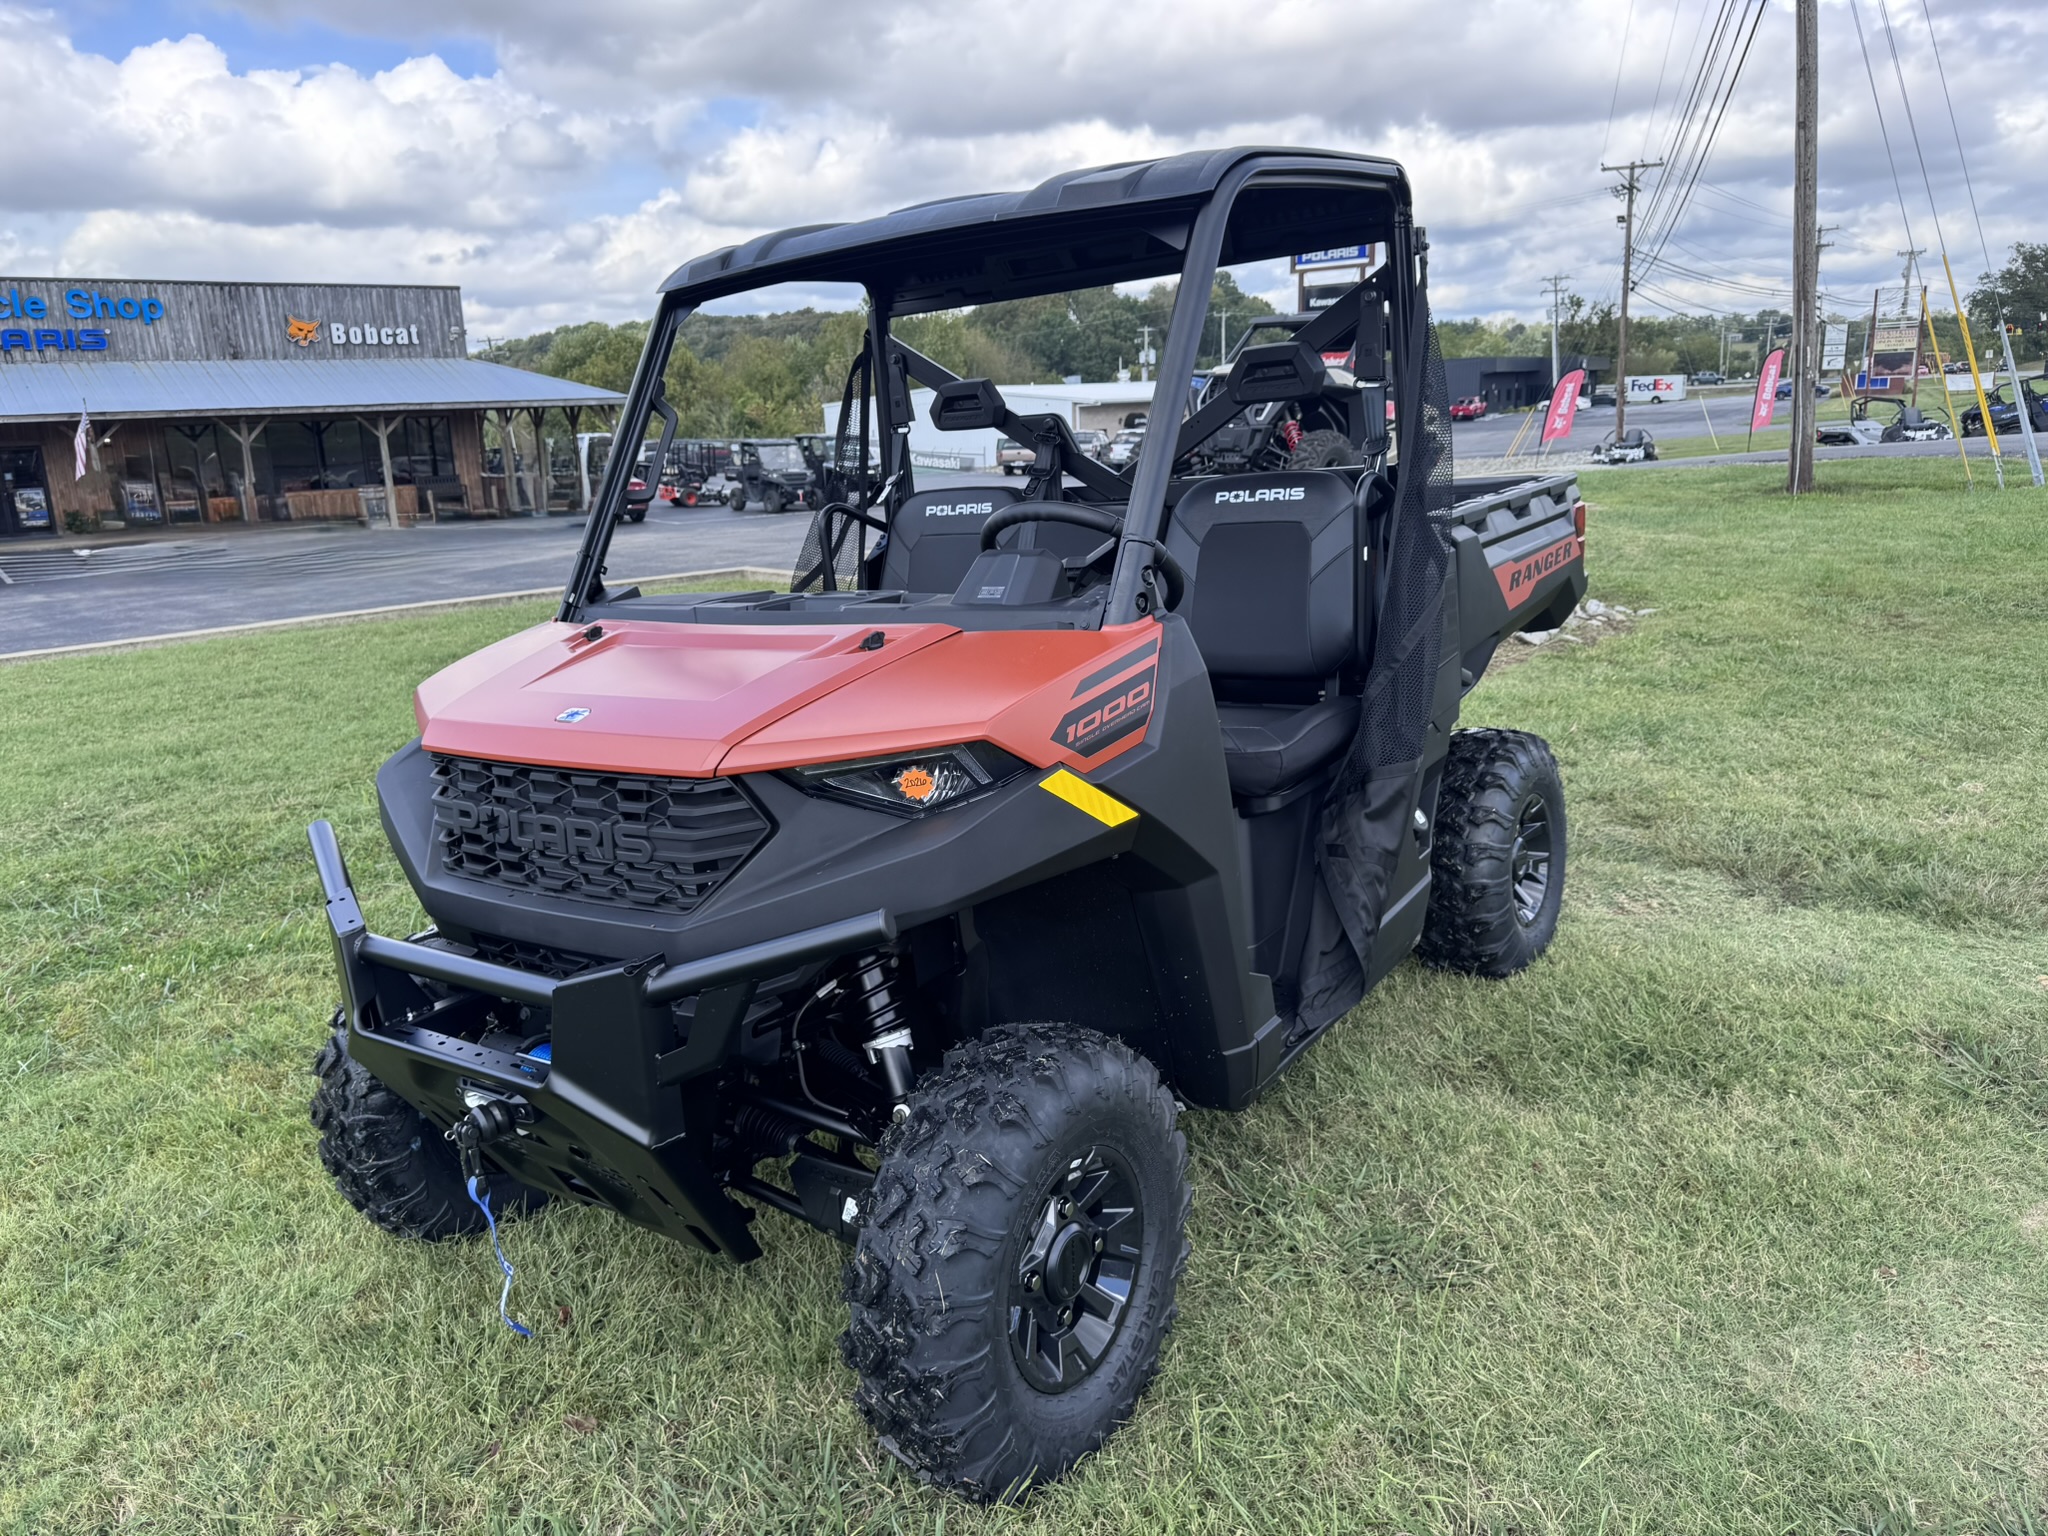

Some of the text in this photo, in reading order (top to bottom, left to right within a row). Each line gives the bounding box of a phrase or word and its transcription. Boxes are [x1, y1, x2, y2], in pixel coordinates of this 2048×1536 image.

[1302, 246, 1359, 262] POLARIS
[65, 289, 164, 325] Shop
[330, 323, 419, 345] Bobcat
[1631, 378, 1673, 392] FedEx
[910, 452, 960, 469] Kawasaki
[1215, 487, 1305, 504] POLARIS
[925, 502, 994, 517] POLARIS
[1509, 541, 1572, 592] RANGER
[1066, 681, 1150, 743] 1000
[1102, 709, 1136, 732] OVERHEAD
[453, 799, 655, 864] POLARIS
[1106, 1270, 1164, 1394] CARLSTAR
